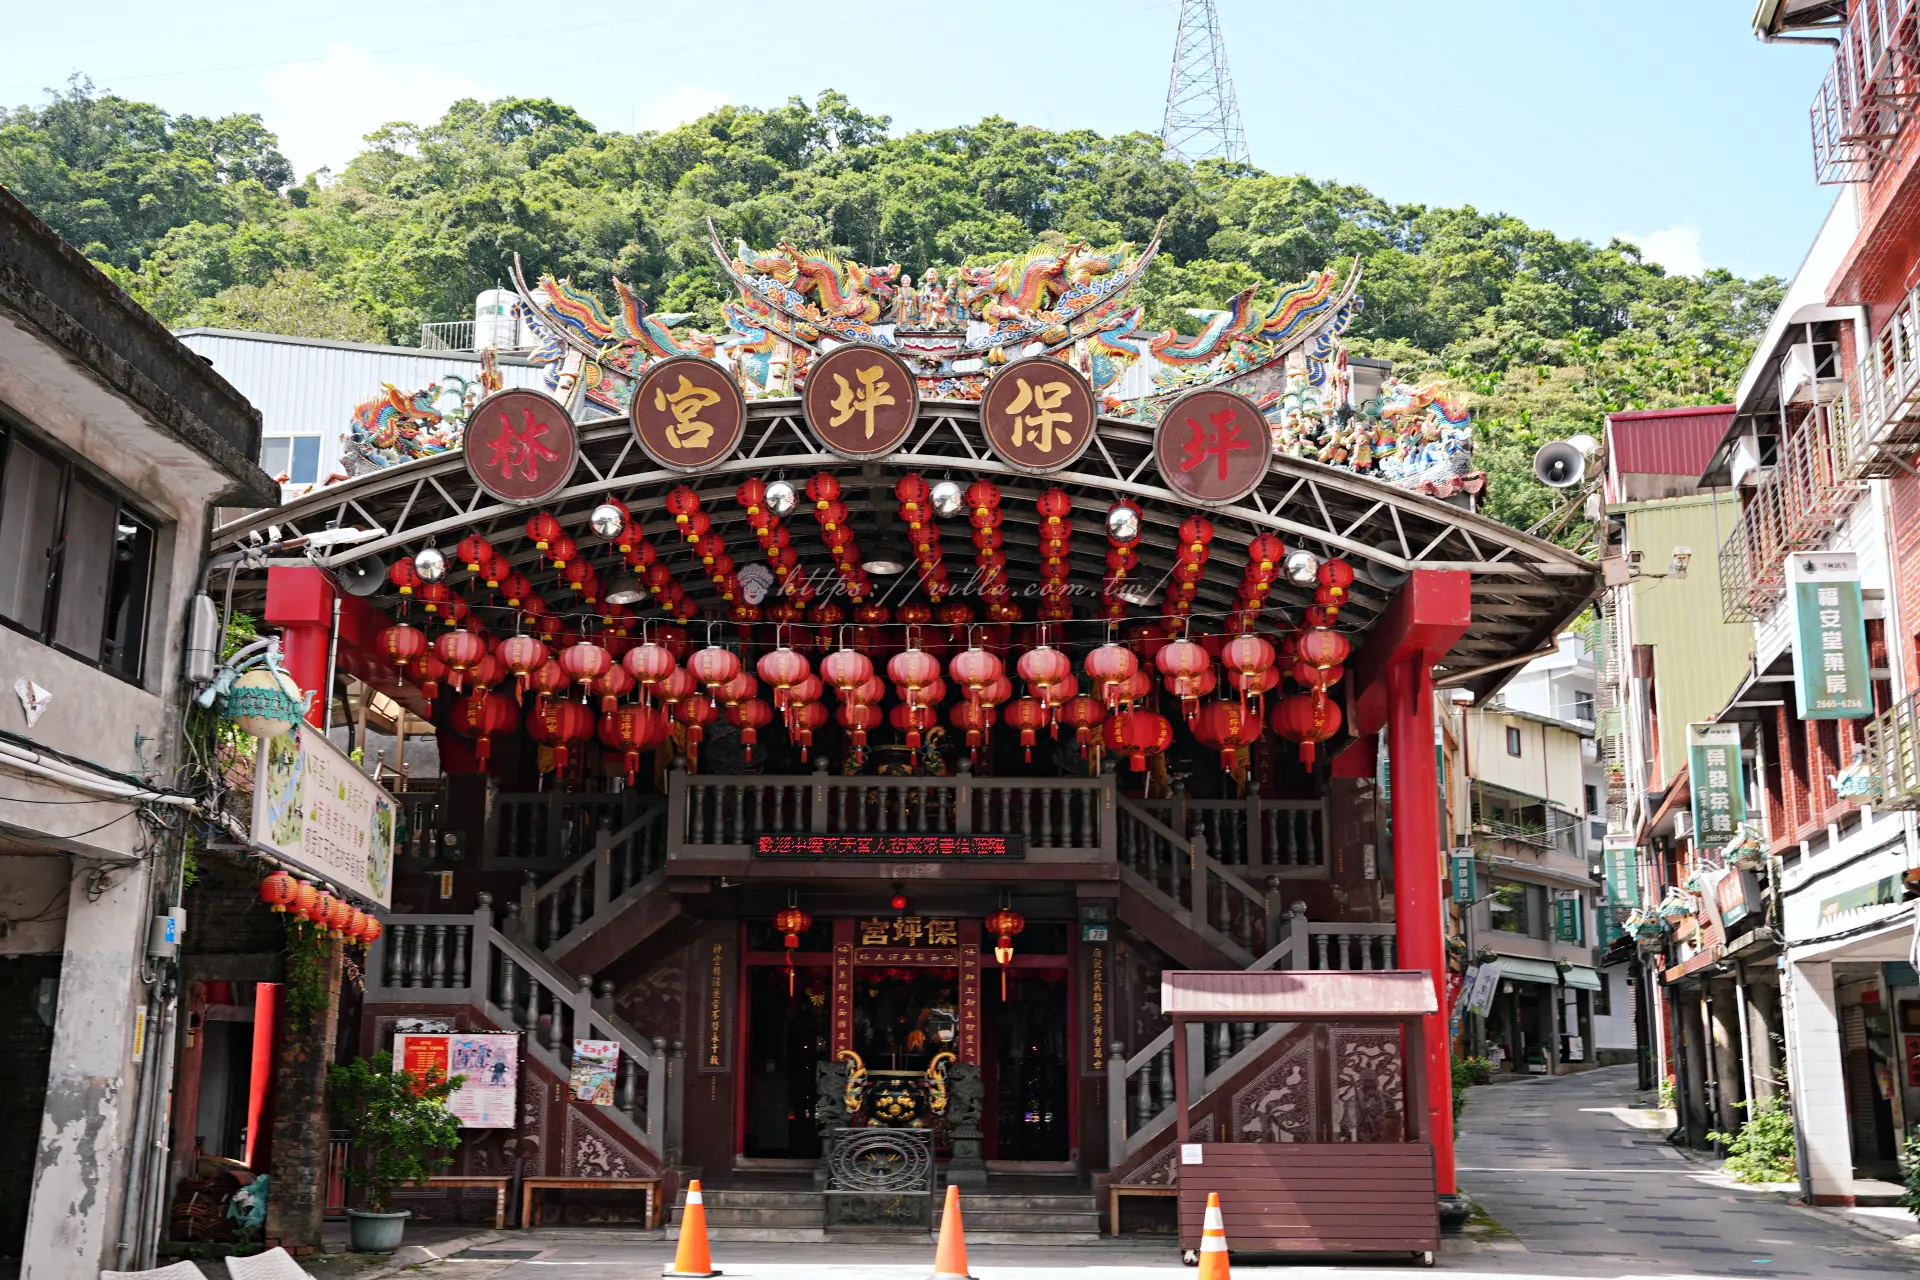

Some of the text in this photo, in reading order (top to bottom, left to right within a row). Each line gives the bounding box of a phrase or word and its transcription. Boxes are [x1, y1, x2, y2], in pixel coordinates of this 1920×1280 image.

[654, 373, 722, 449] 宮
[830, 365, 895, 440] 坪
[1006, 379, 1074, 454] 保
[485, 408, 560, 480] 林
[1180, 407, 1252, 482] 坪
[1817, 587, 1848, 694] 福安堂藥房
[1815, 699, 1864, 709] 2665-6266
[1093, 930, 1104, 940] 79
